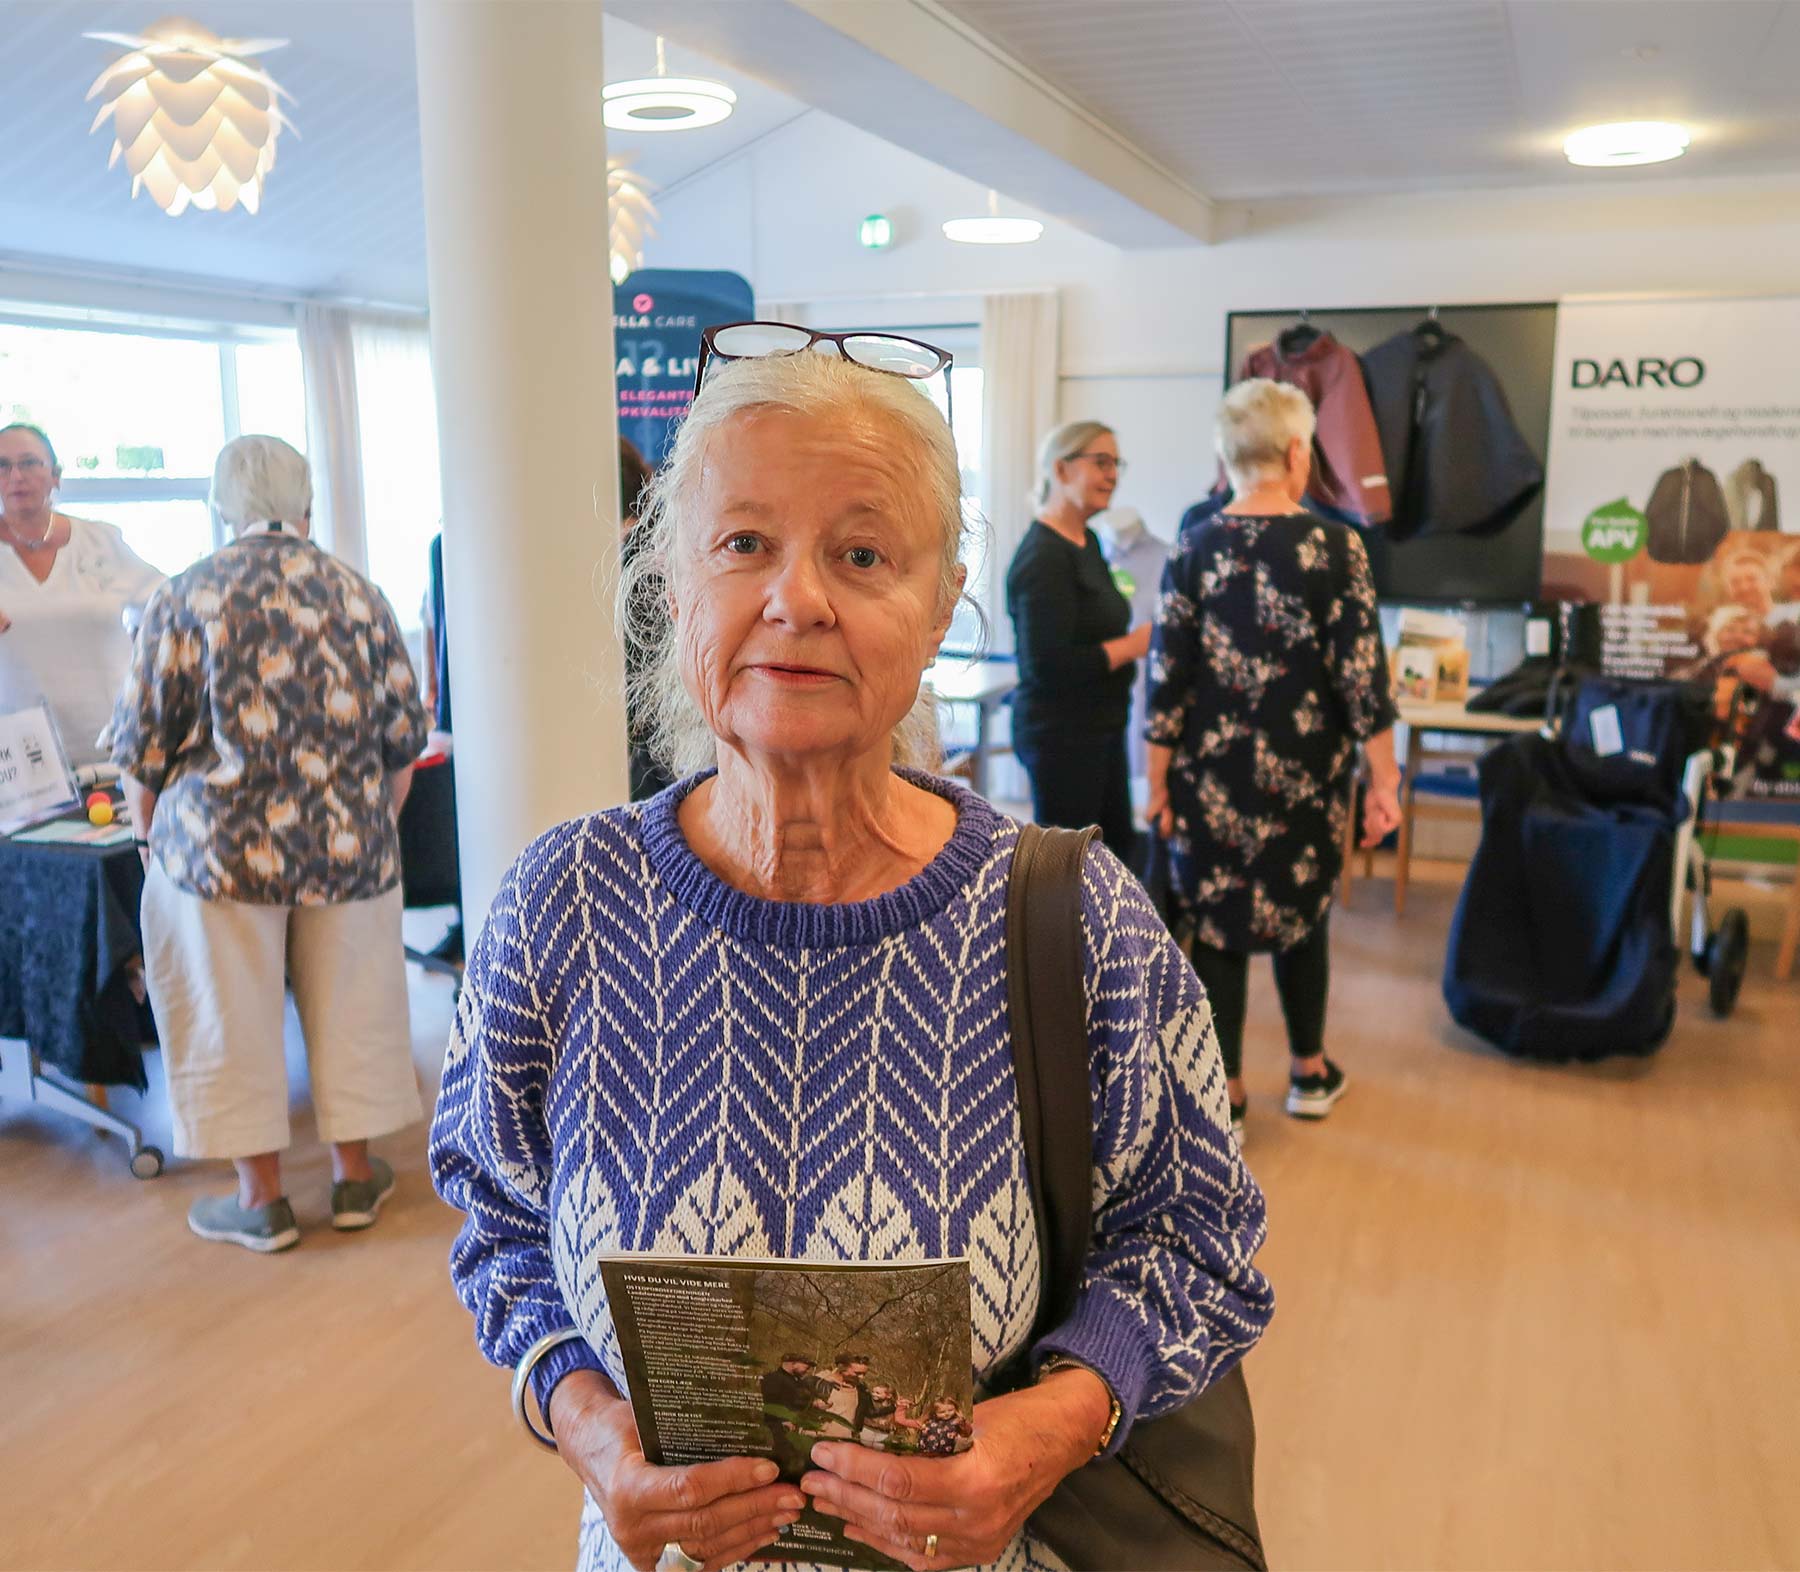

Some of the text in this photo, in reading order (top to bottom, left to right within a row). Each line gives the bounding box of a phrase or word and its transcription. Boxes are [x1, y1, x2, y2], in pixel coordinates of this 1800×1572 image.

[655, 316, 696, 328] CARE
[641, 357, 661, 377] &
[1571, 357, 1706, 389] DARO
[1588, 527, 1639, 550] APV
[623, 1274, 731, 1289] HVIS DU VIL VIDE MERE
